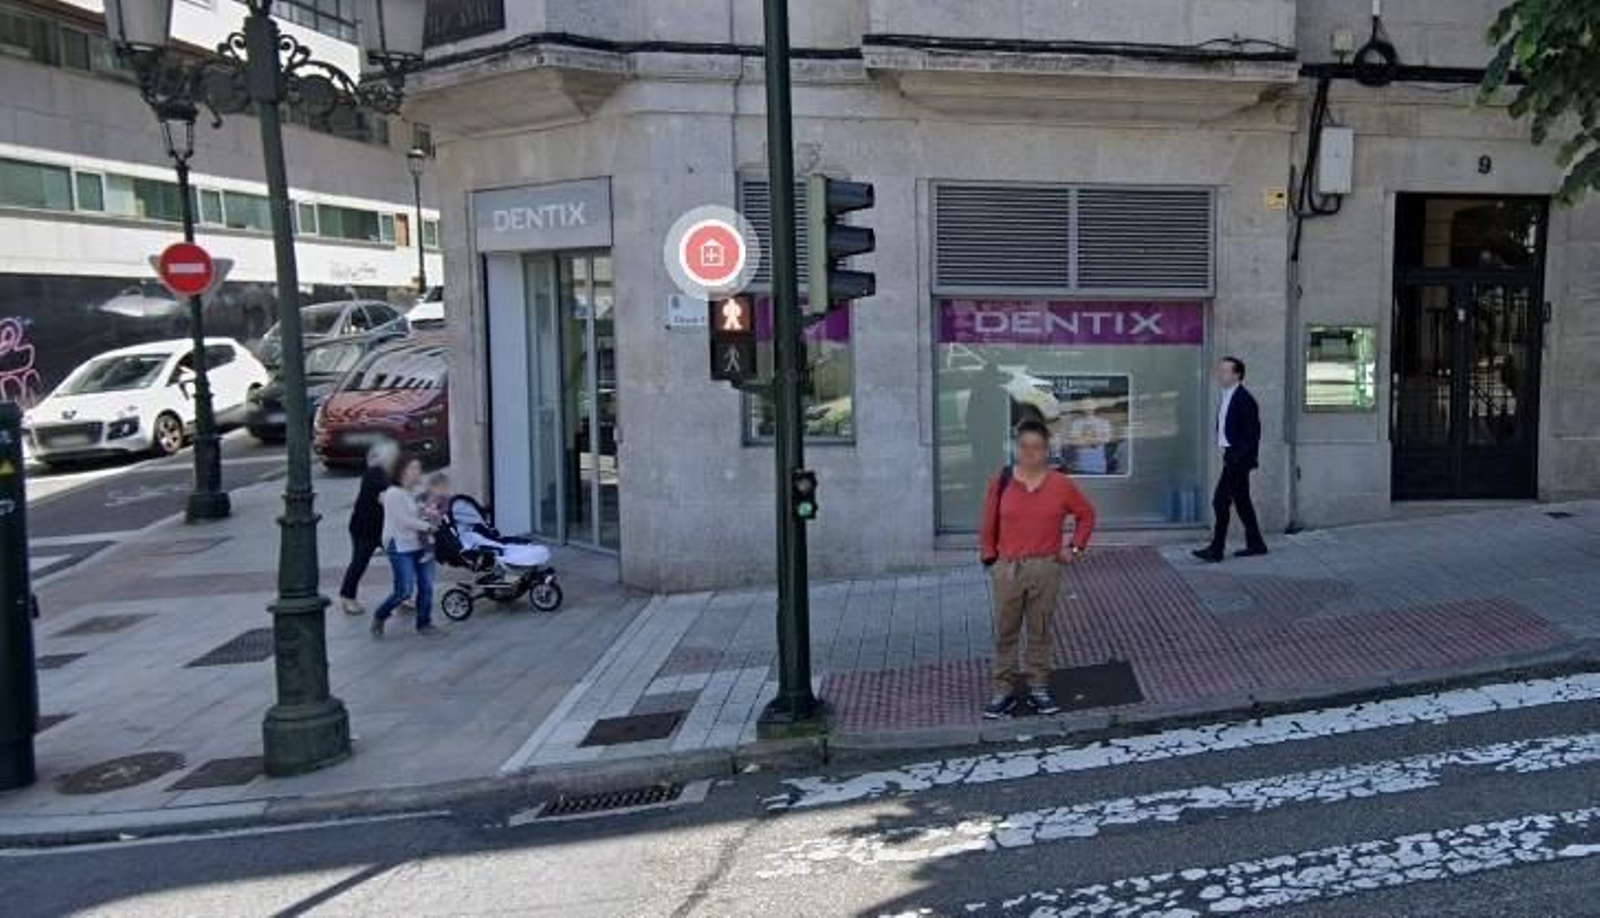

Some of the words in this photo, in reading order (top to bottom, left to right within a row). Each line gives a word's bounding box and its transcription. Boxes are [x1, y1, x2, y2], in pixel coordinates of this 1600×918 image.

[1478, 155, 1492, 175] 9
[493, 202, 586, 231] DENTIX
[975, 311, 1164, 335] DENTIX
